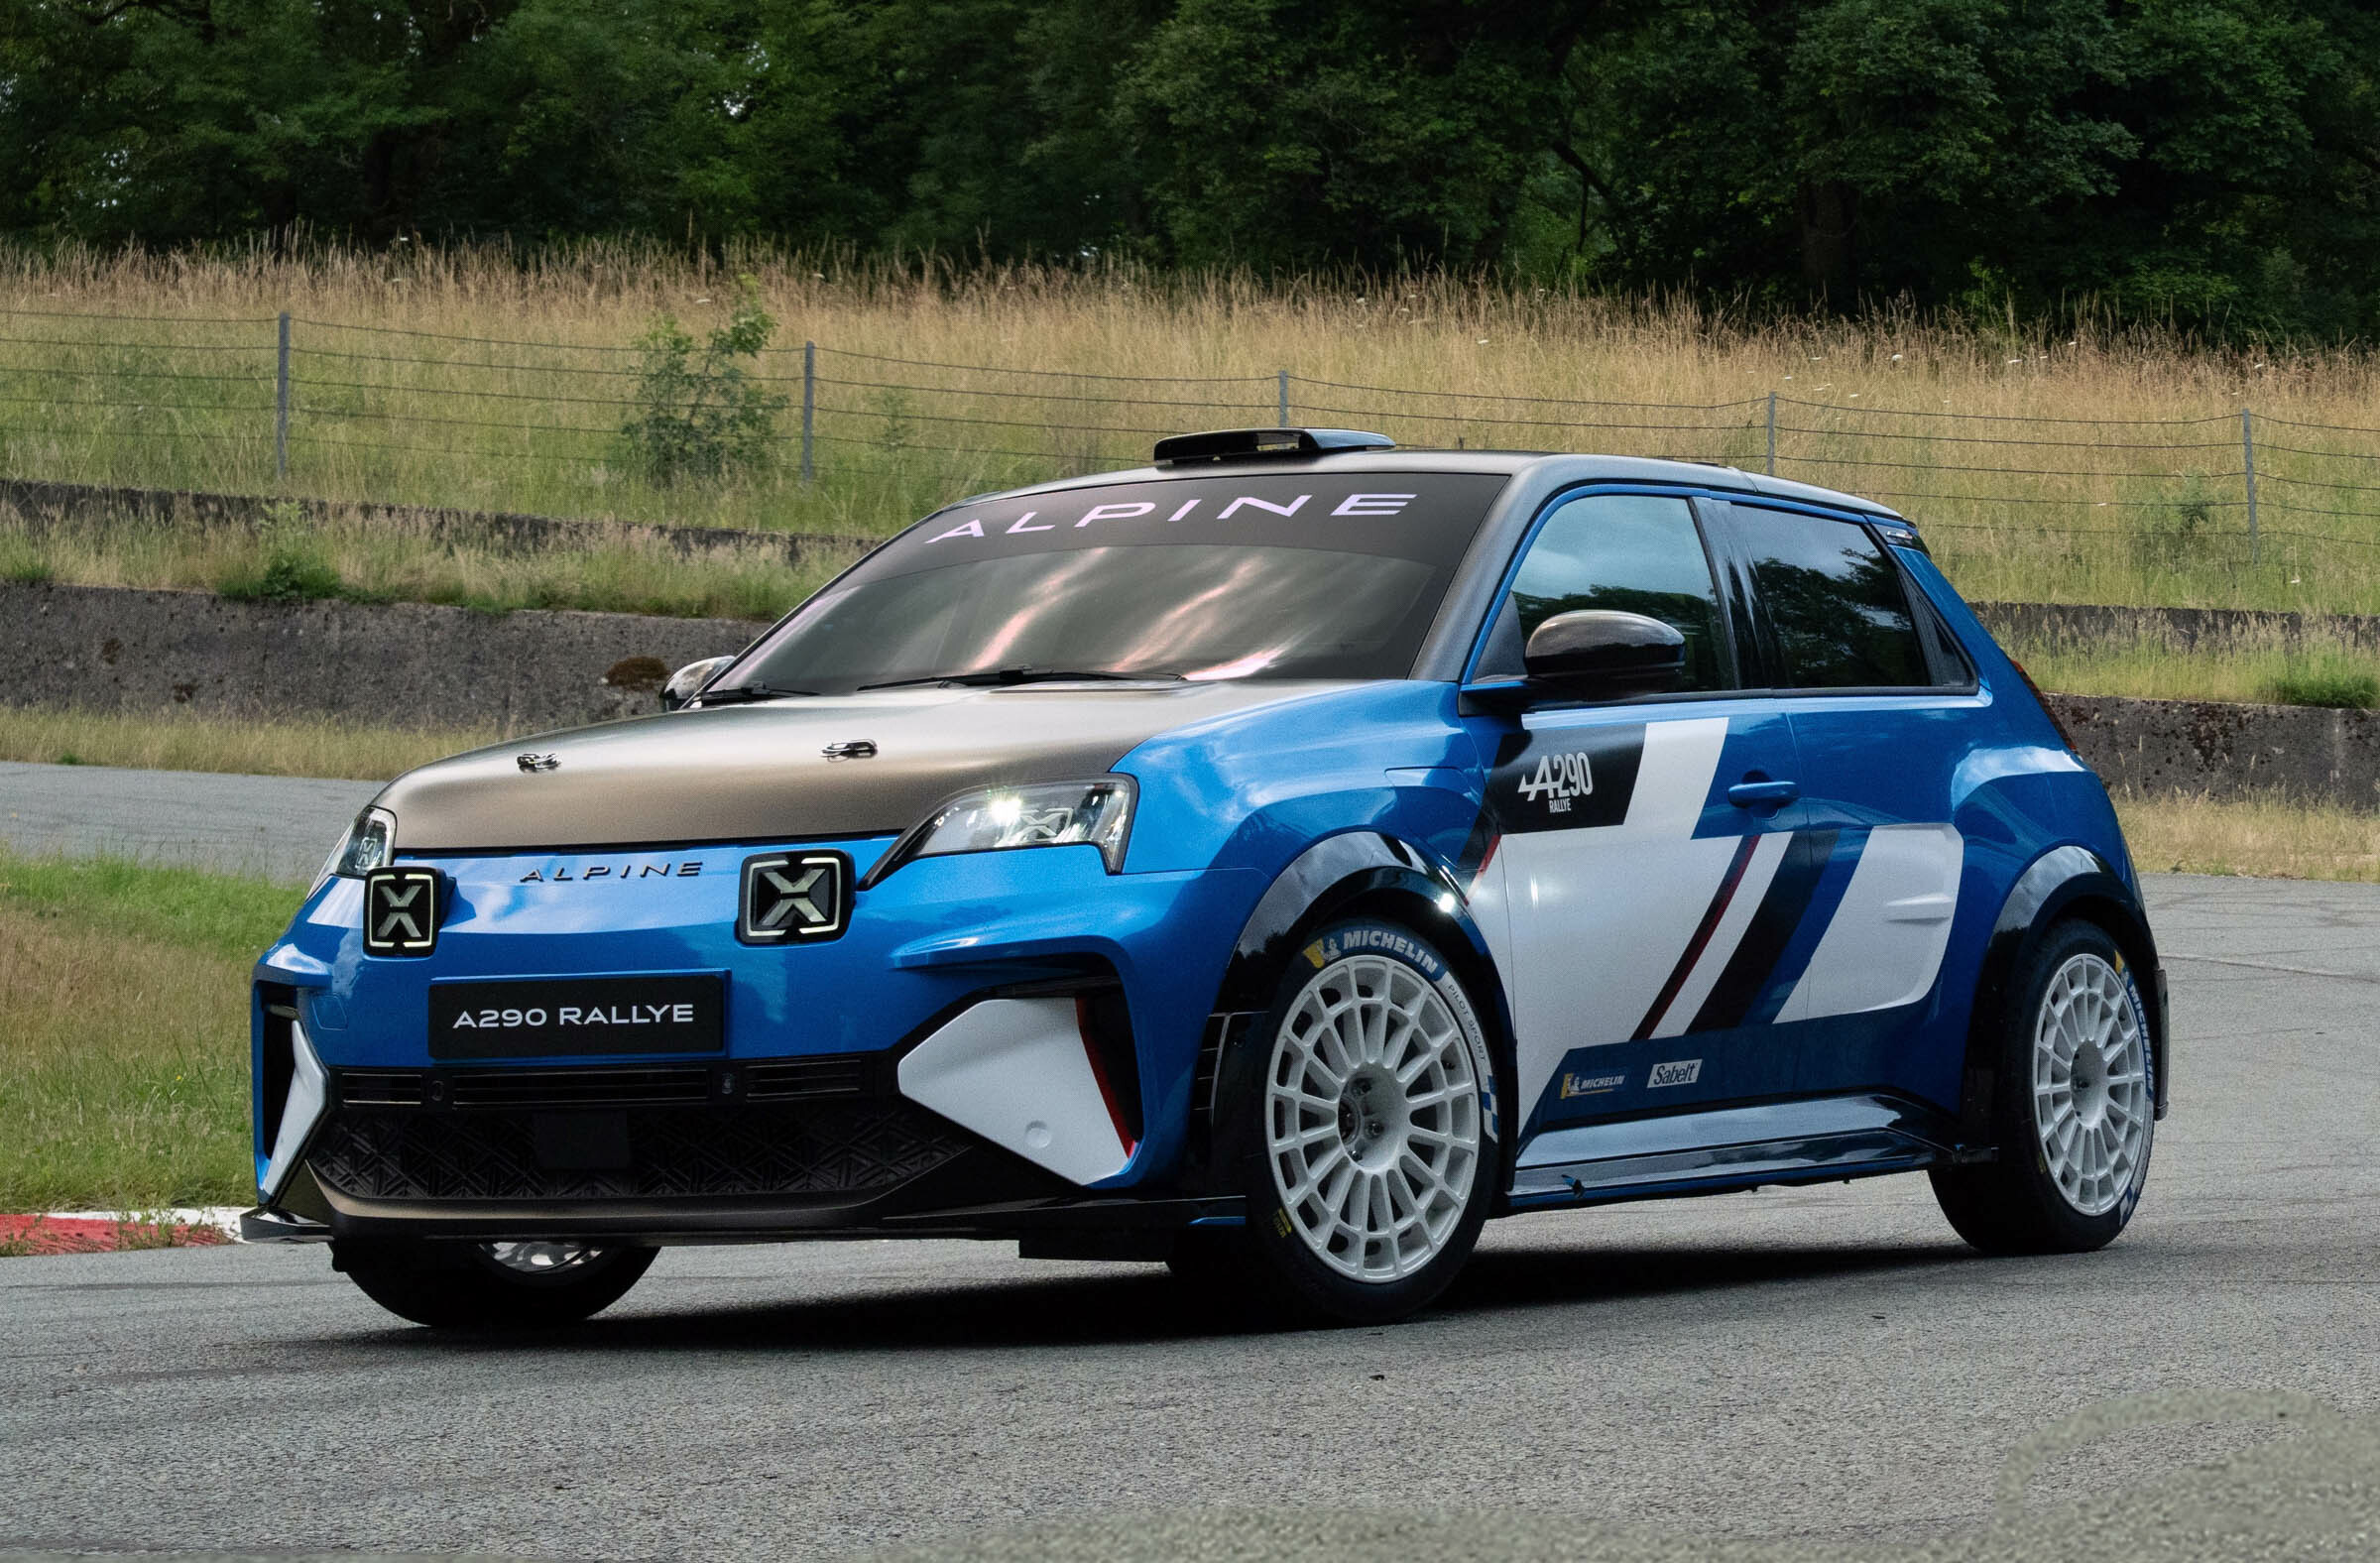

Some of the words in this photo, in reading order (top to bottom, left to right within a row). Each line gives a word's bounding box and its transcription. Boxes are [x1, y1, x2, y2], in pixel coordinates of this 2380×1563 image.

[925, 494, 1418, 543] ALPINE
[1518, 752, 1594, 801] A290
[1548, 798, 1572, 813] RALLYE
[520, 861, 703, 883] ALPINE
[1343, 930, 1438, 974] MICHELIN
[1448, 984, 1470, 1016] PILOT
[452, 1008, 547, 1028] A290
[559, 1004, 694, 1025] RALLYE
[1581, 1075, 1625, 1090] MICHELIN
[1653, 1062, 1697, 1086] Sabelt
